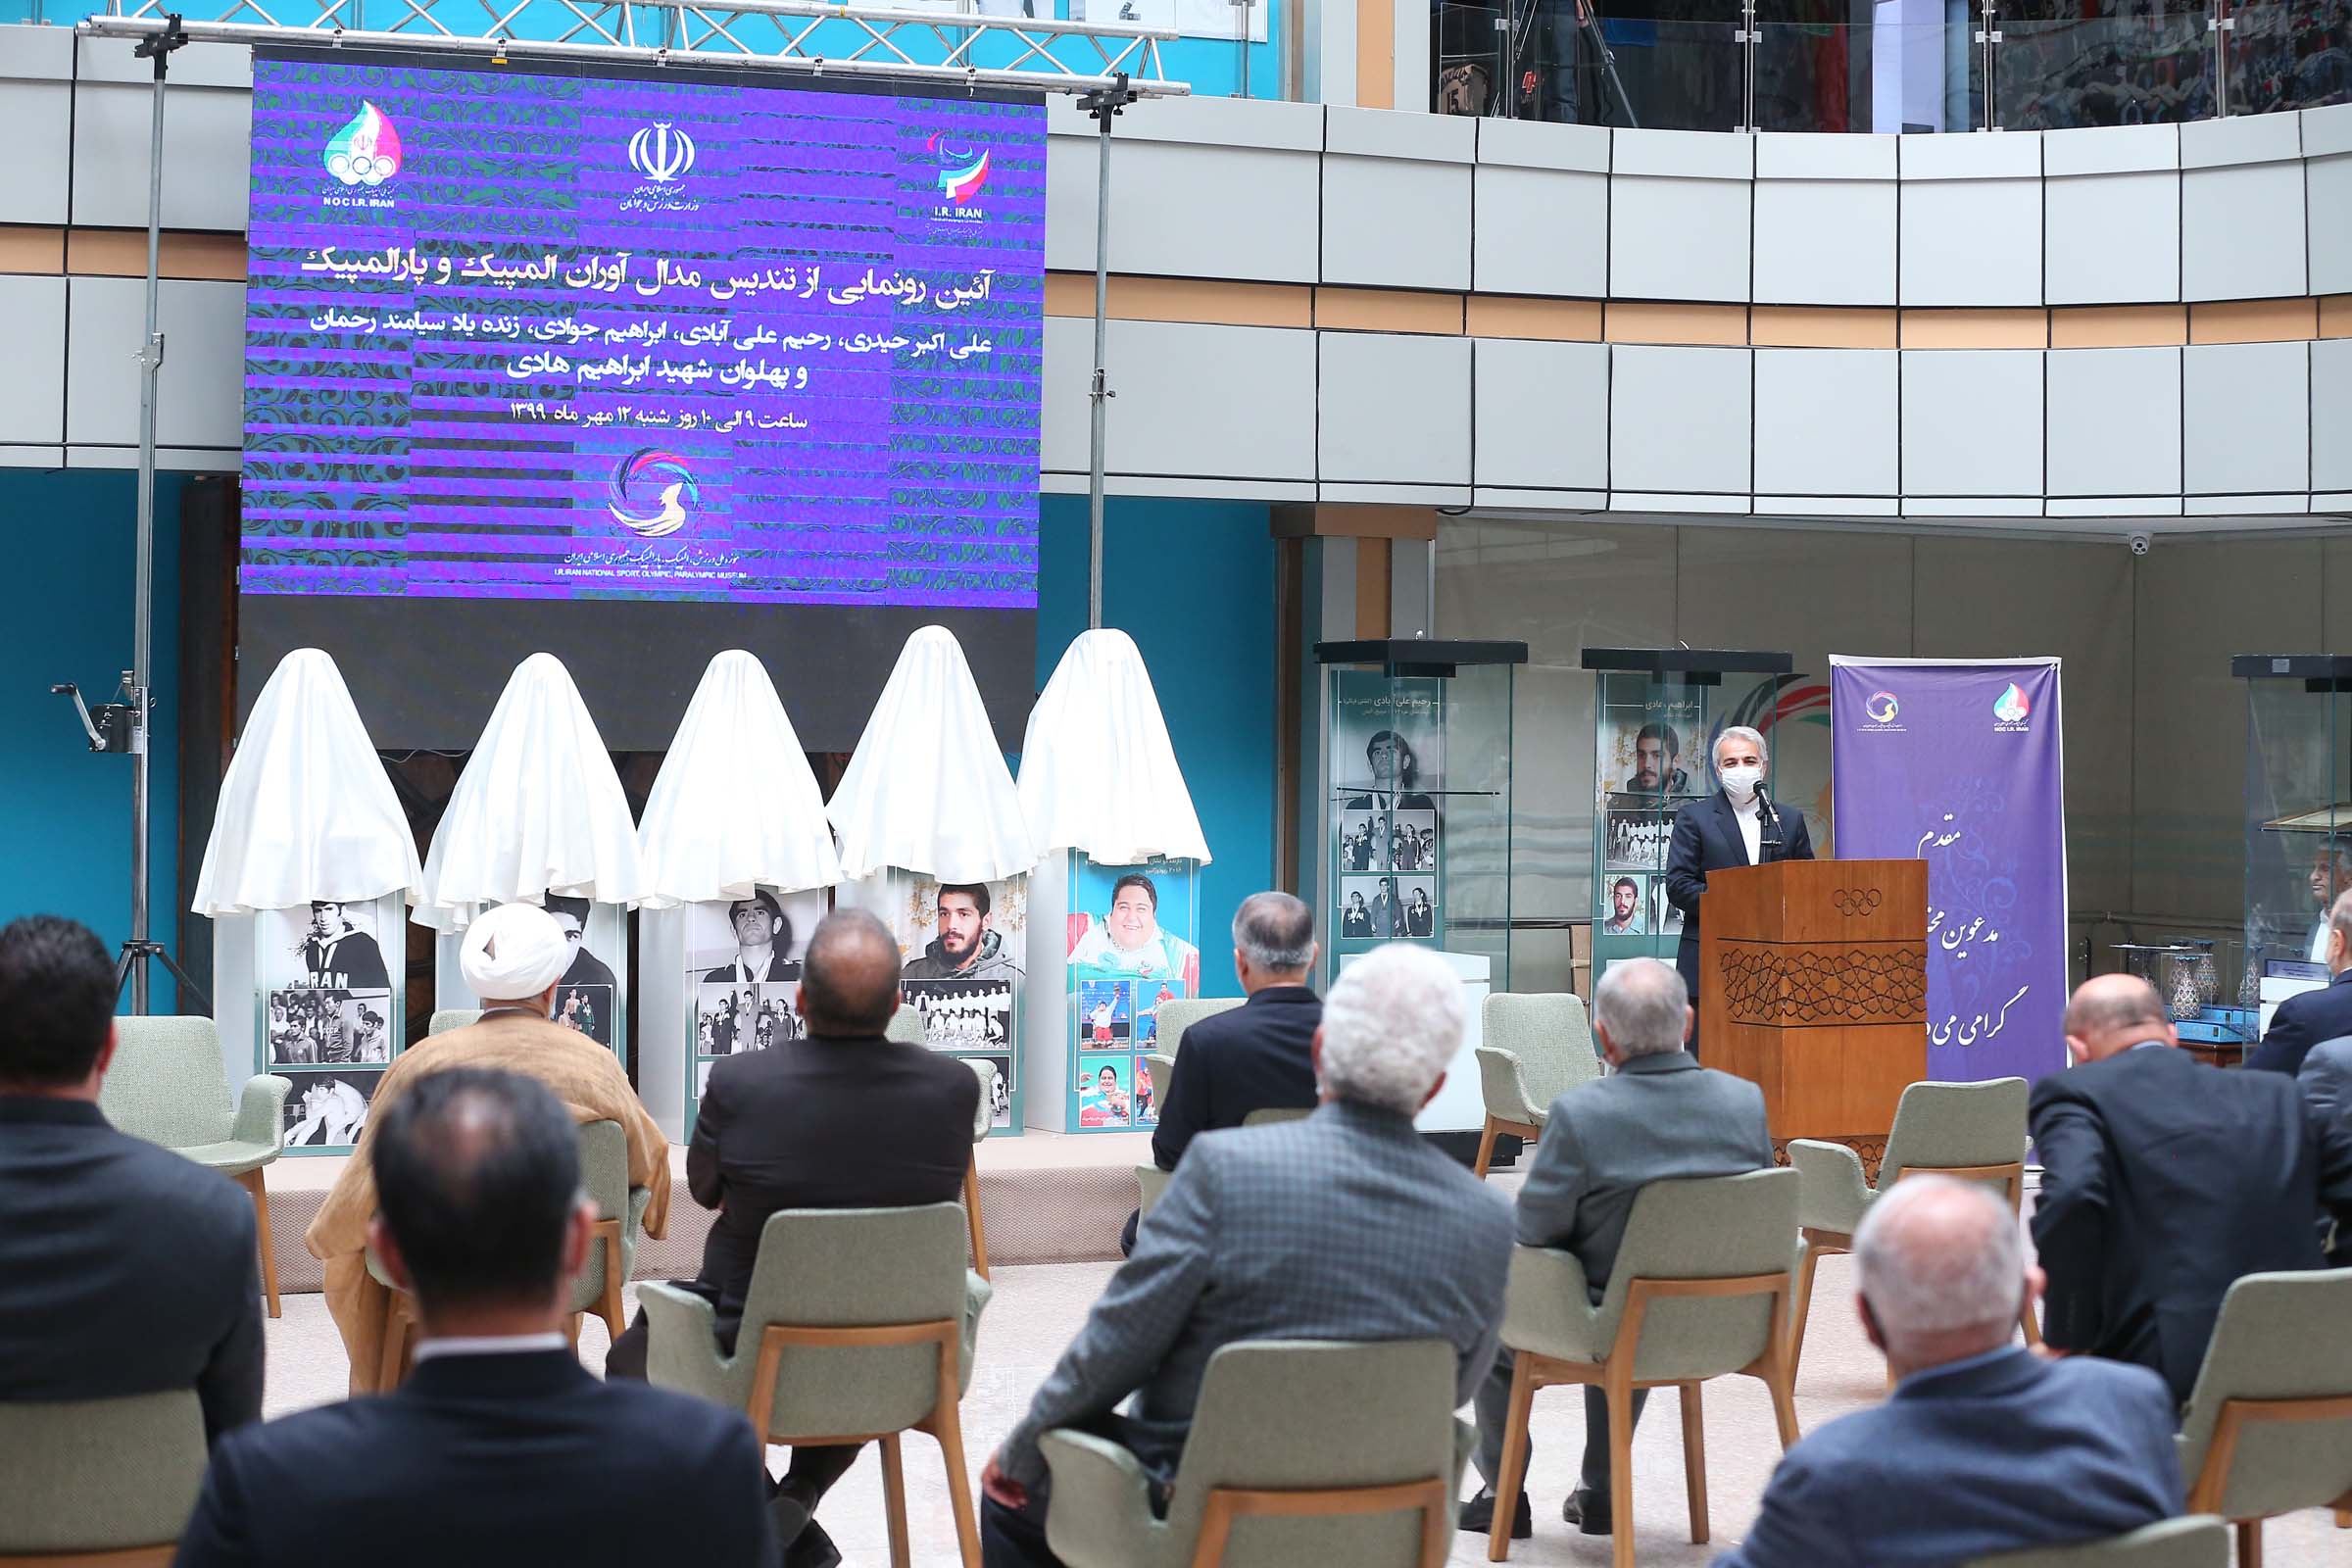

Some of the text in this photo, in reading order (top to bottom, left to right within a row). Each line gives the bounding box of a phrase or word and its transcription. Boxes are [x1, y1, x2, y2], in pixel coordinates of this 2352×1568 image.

[633, 185, 651, 197] ایران
[369, 199, 395, 208] IRAN
[619, 195, 644, 213] جوانان
[669, 199, 700, 211] وزارت
[934, 207, 983, 218] I.R. IRAN
[434, 255, 452, 285] و
[564, 251, 633, 292] آوران
[635, 258, 702, 296] مدال
[710, 263, 797, 301] تندیس
[798, 266, 820, 300] از
[827, 268, 927, 306] رونمایی
[309, 307, 377, 333] رحمان
[382, 311, 446, 334] سیامند
[452, 312, 476, 336] یاد
[481, 315, 520, 338] زنده
[604, 319, 667, 348] ابراهیم
[733, 322, 777, 351] علی
[782, 332, 831, 353] رحیم
[911, 332, 946, 359] اکبر
[949, 333, 993, 360] علی
[506, 351, 808, 389] و پهلوان شهید ابراهیم هادی
[510, 402, 808, 432] ساعت ۹ الی ۱۰ روز شنبه ۱۲ مهر ماه ۱۳۹۹
[564, 552, 584, 566] ایران
[583, 551, 606, 564] اسلامی
[606, 550, 630, 565] جمهوری
[724, 553, 740, 564] موزه
[582, 568, 615, 577] NATIONAL
[616, 569, 641, 578] SPORT,
[1411, 698, 1431, 709] رحیم
[1667, 700, 1693, 711] ابراهیم
[1941, 915, 1999, 958] مدعوین
[1957, 984, 2030, 1046] گرامی
